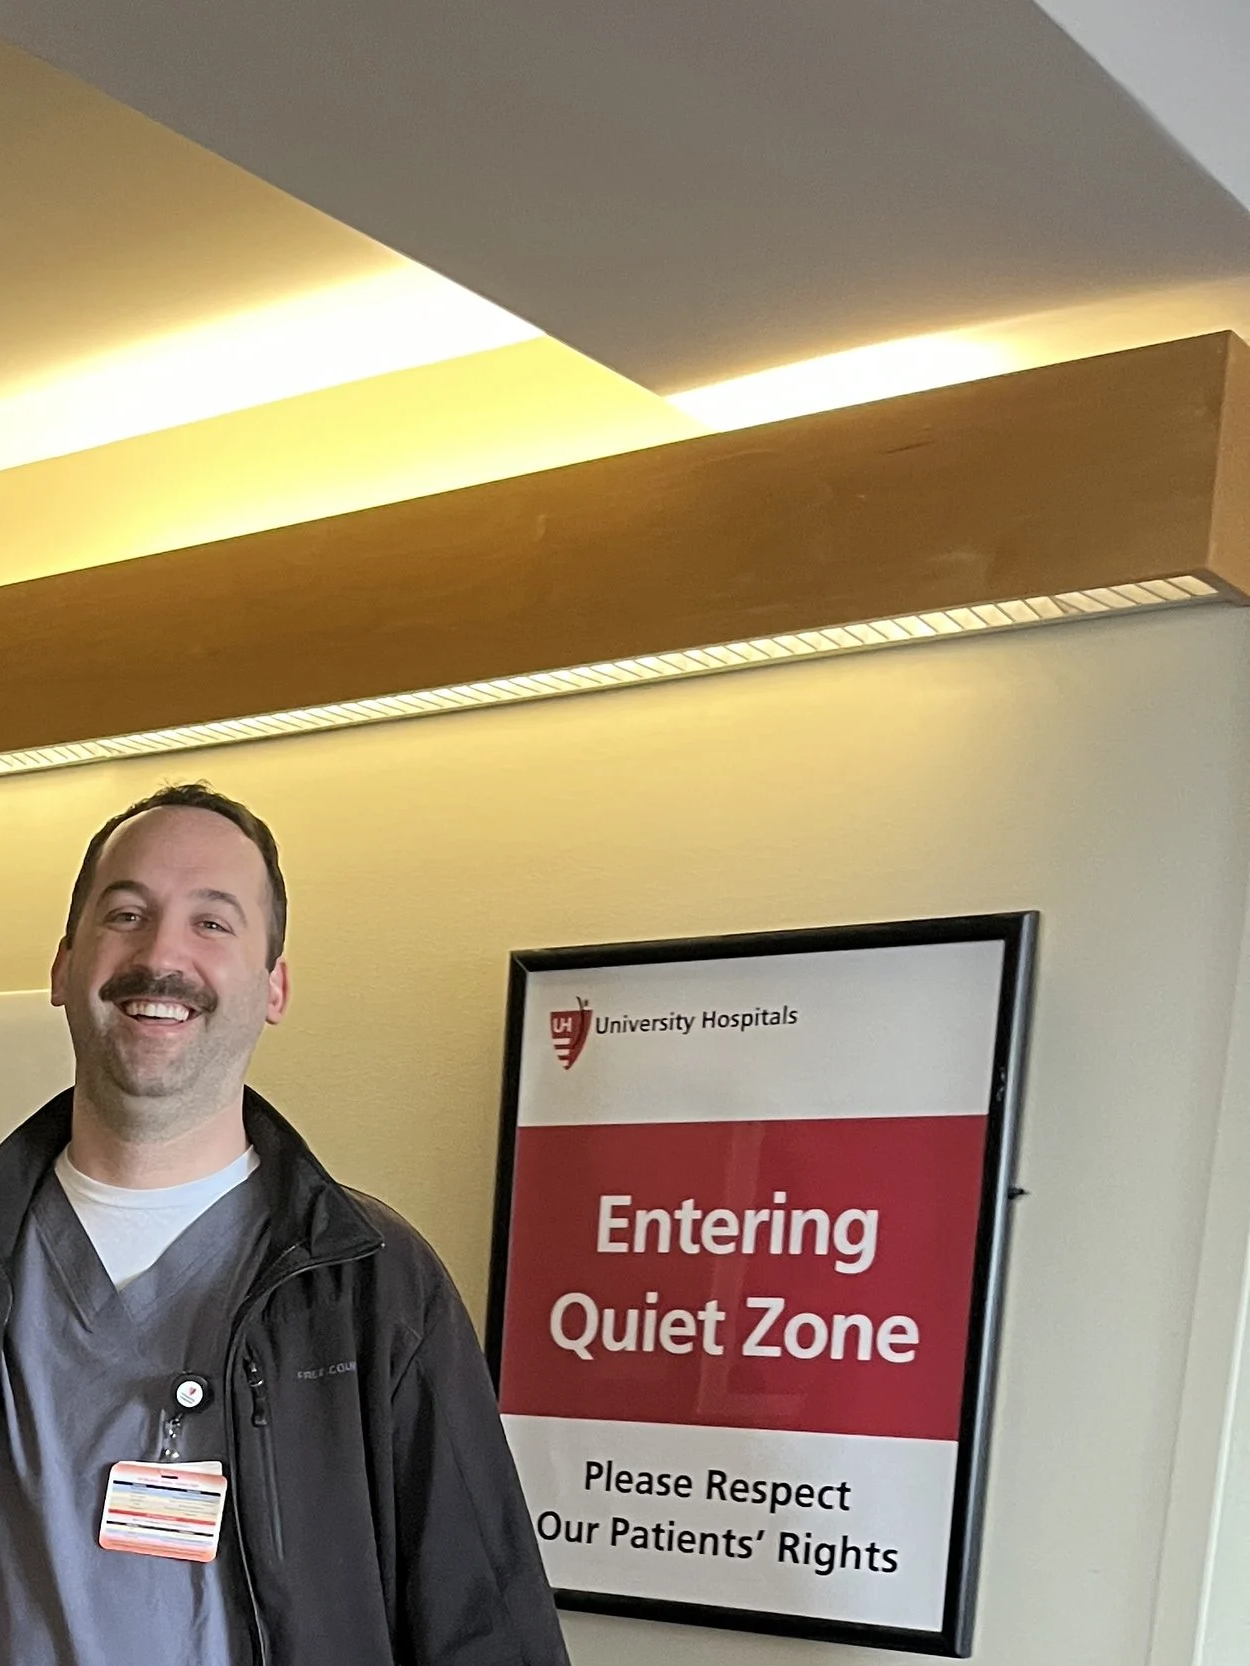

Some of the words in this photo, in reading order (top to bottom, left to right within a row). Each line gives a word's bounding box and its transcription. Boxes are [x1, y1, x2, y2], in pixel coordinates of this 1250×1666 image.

[595, 1011, 696, 1035] University
[701, 1005, 799, 1032] Hospitals
[596, 1190, 880, 1275] Entering
[550, 1291, 726, 1361] Quiet
[741, 1296, 920, 1364] Zone
[584, 1460, 693, 1498] Please
[705, 1469, 852, 1514] Respect
[536, 1510, 600, 1545] Our
[609, 1517, 765, 1560] Patients'
[777, 1531, 899, 1577] Rights
